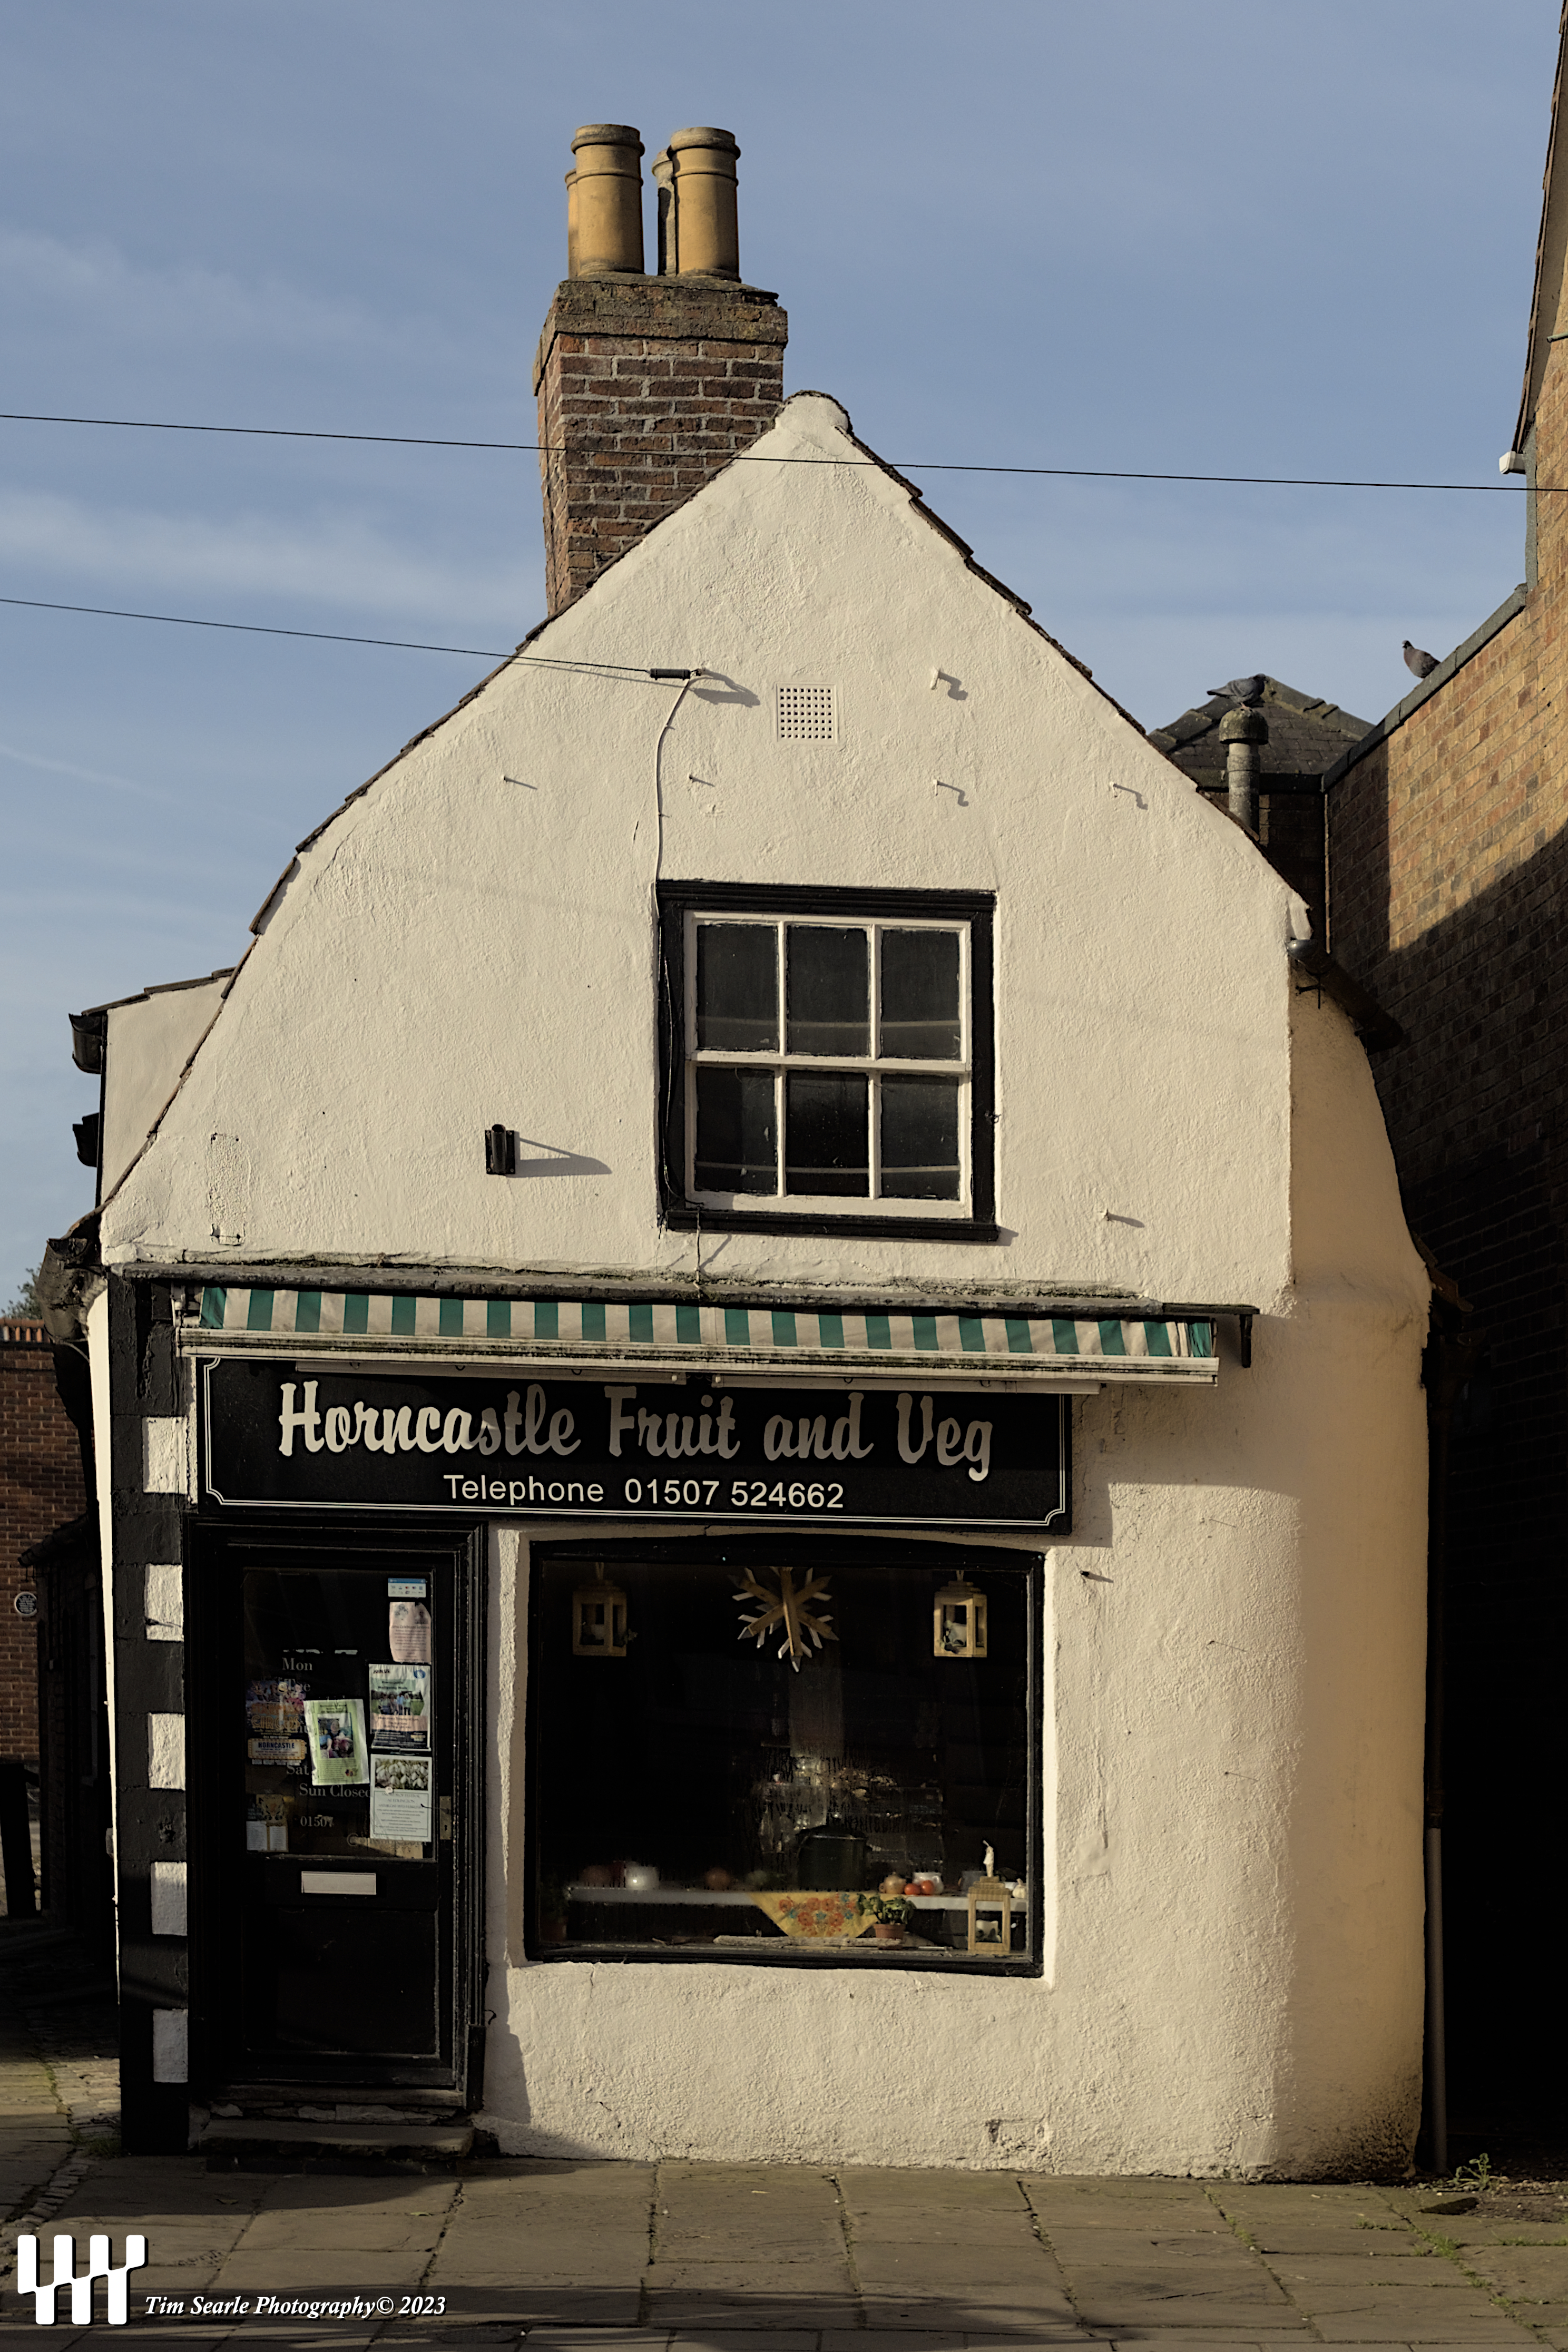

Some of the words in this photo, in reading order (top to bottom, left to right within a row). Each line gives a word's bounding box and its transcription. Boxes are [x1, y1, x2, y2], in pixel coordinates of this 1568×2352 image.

[279, 1380, 581, 1457] Horncastle
[604, 1386, 740, 1459] Fruit
[764, 1393, 874, 1461] and
[896, 1393, 993, 1481] Veg
[444, 1475, 604, 1506] Telephone
[625, 1479, 720, 1505] 01507
[731, 1481, 844, 1508] 524662
[282, 1658, 312, 1671] Mon
[251, 1715, 301, 1729] CIRCUS
[286, 1763, 309, 1776] Sat
[299, 1782, 327, 1796] Sun
[300, 1816, 334, 1827] 01507
